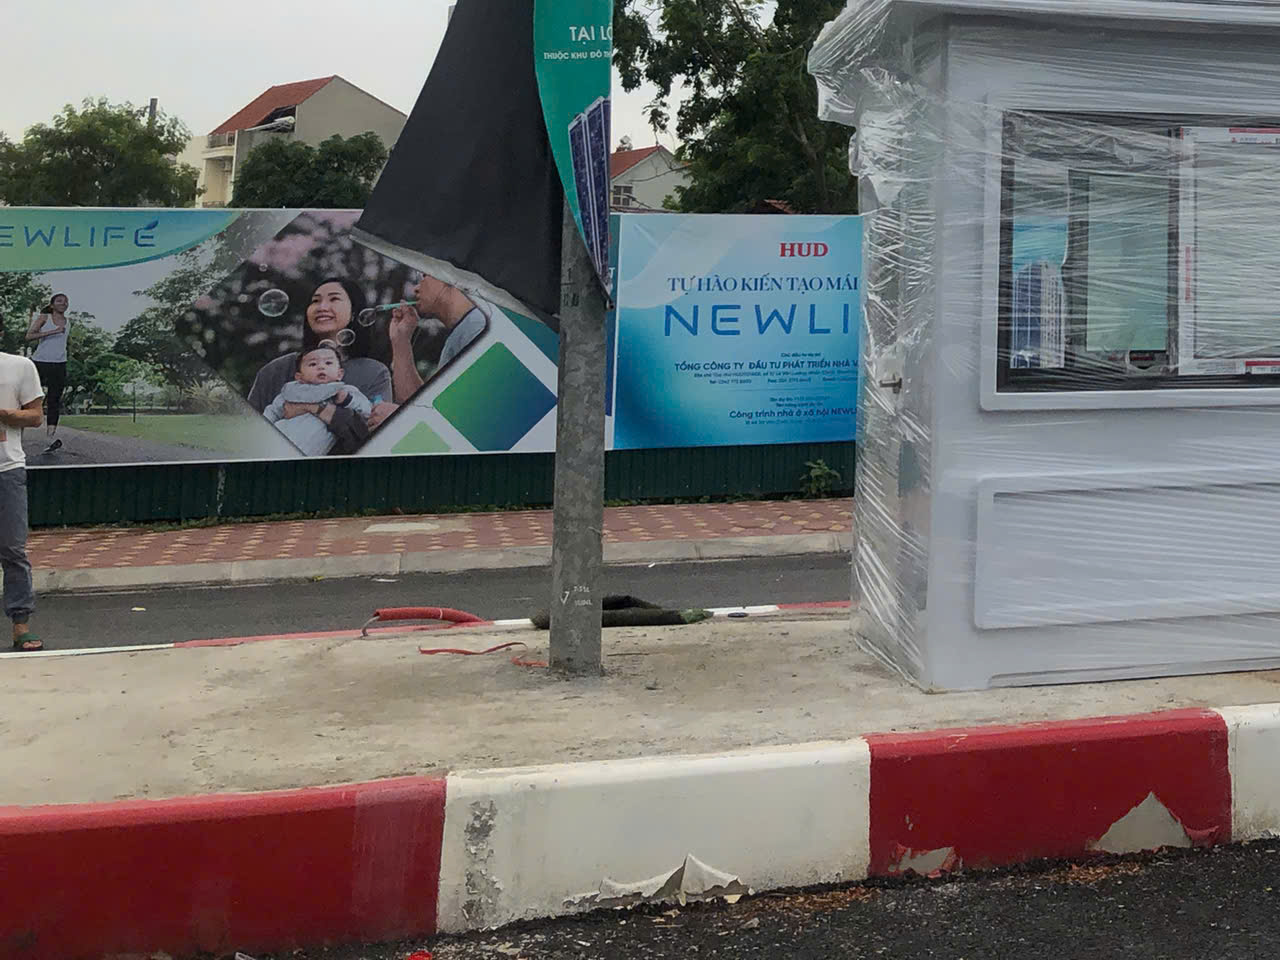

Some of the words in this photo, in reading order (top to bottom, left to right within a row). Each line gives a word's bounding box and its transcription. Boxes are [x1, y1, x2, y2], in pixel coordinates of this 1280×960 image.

[569, 26, 595, 45] TẠI
[571, 52, 587, 60] KHU
[779, 242, 829, 258] HUD
[667, 275, 696, 295] TỰ
[697, 274, 737, 292] HÀO
[741, 272, 783, 292] KIẾN
[786, 276, 823, 295] TẠO
[703, 360, 731, 370] CÔNG
[733, 362, 744, 370] TY
[783, 359, 805, 369] PHÁT
[729, 410, 753, 420] Công
[755, 408, 776, 418] trình
[777, 408, 794, 417] nhà
